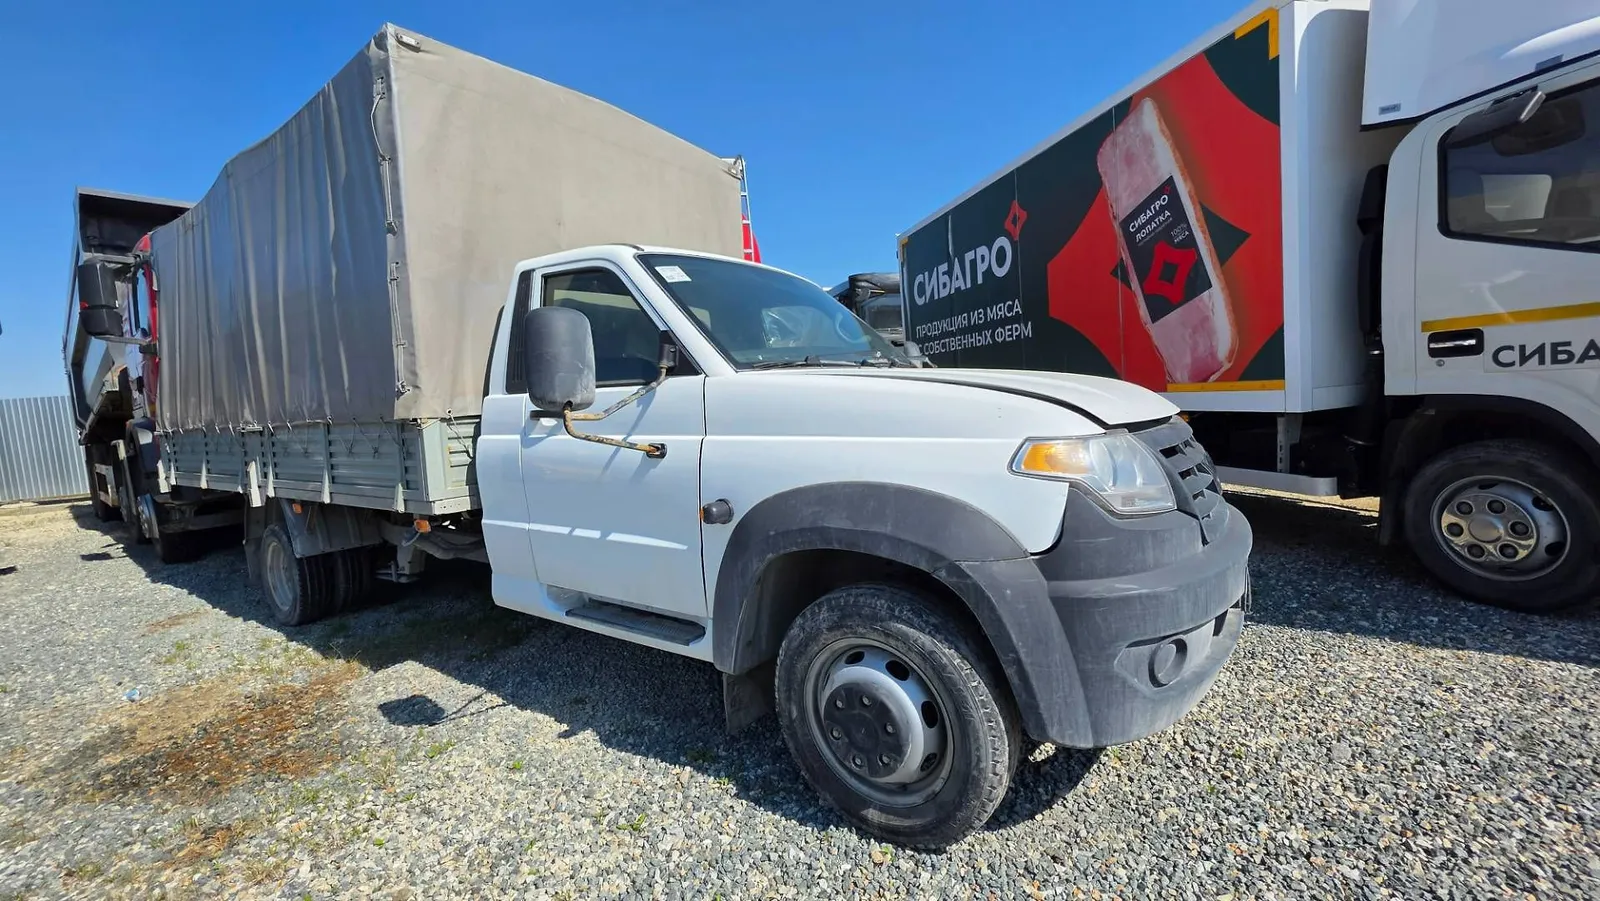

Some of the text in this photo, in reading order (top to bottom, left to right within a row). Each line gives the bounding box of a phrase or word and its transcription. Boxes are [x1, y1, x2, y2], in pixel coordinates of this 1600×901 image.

[1129, 194, 1169, 232] СИБАГРО
[1135, 210, 1171, 243] ЛОПАТКА
[914, 237, 1012, 305] СИБАГРО
[916, 298, 1022, 338] ПРОДУКЦИЯ ИЗ МЯСА
[923, 329, 993, 356] СОБСТВЕННЫХ
[994, 321, 1032, 343] ФЕРМ
[1492, 338, 1600, 368] СИБА
